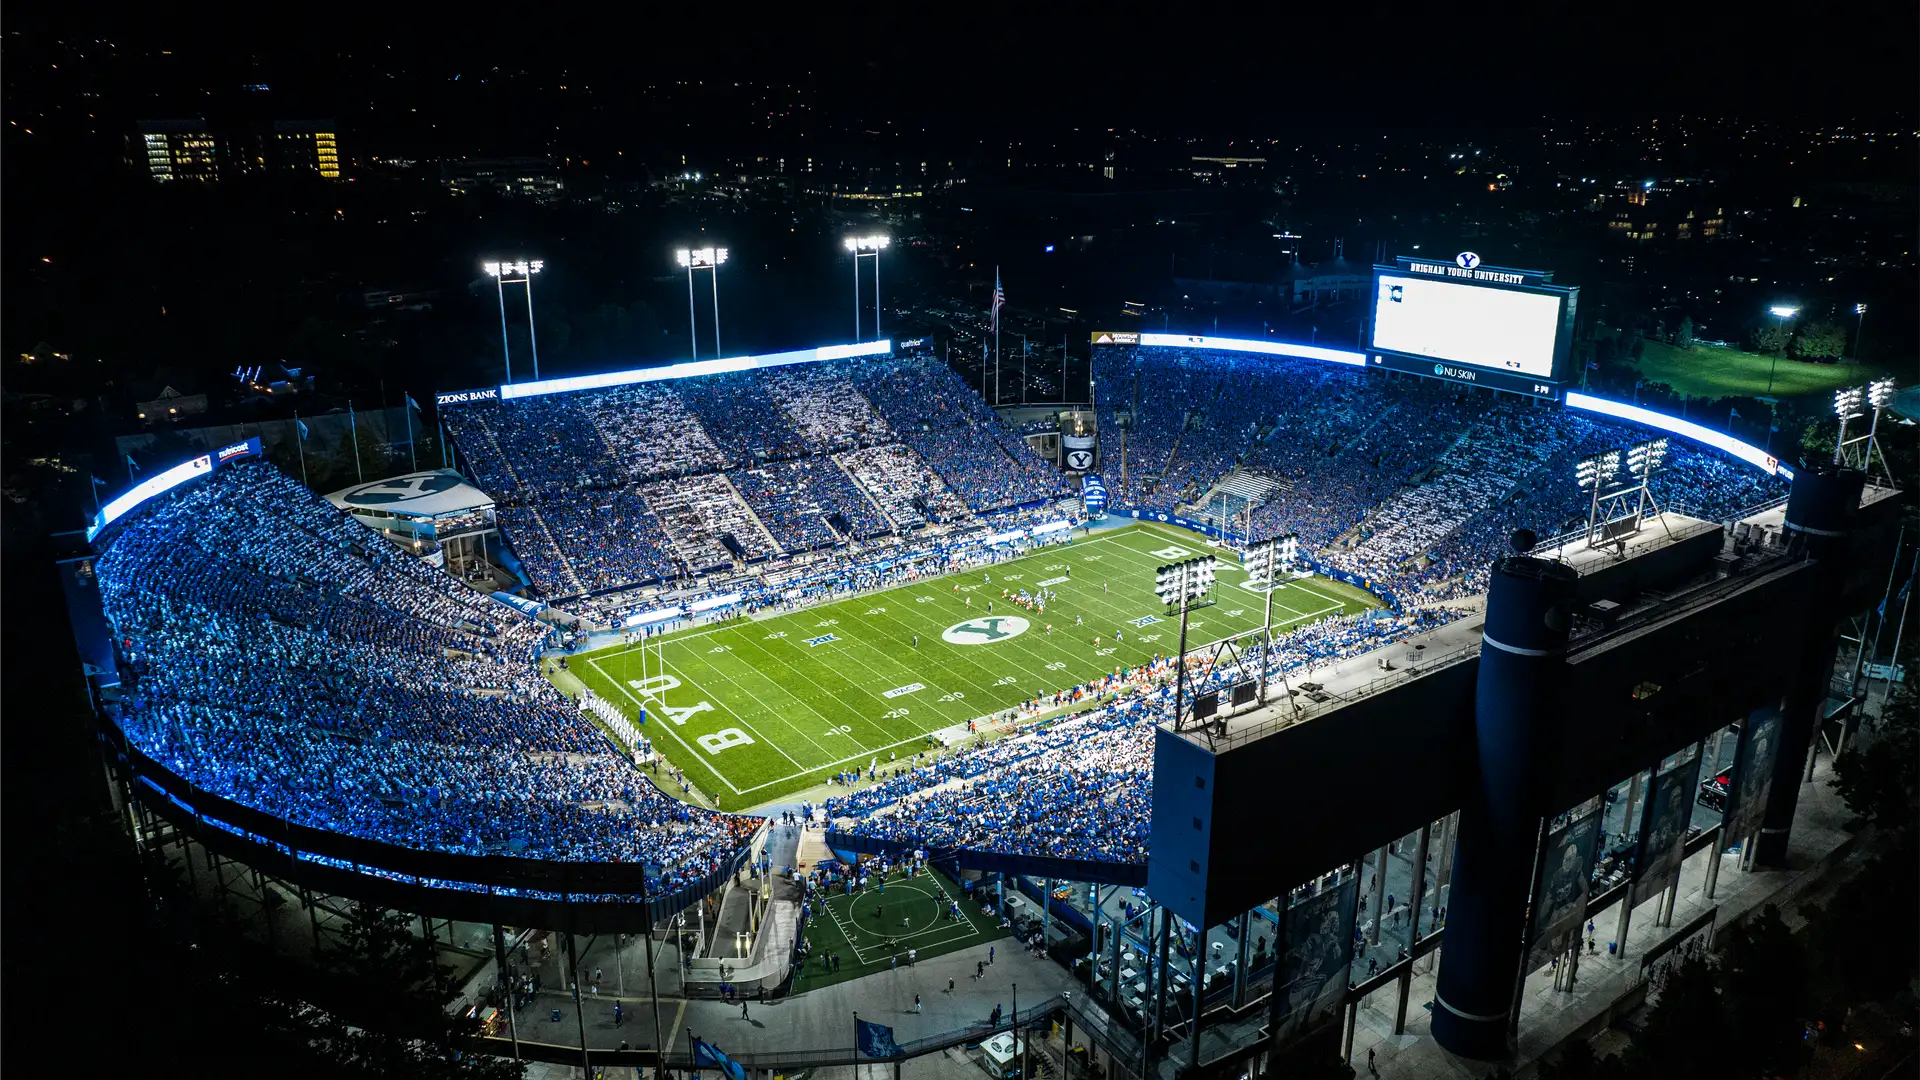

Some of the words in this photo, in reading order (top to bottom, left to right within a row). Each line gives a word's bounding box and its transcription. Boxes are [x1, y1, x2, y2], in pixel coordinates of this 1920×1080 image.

[1460, 254, 1476, 267] Y
[1410, 263, 1445, 275] BRIGHAM
[1447, 266, 1472, 278] YOUNG
[1474, 270, 1524, 284] UNIVERSITY
[1444, 367, 1457, 377] NU
[1458, 369, 1476, 381] SKIN
[437, 393, 468, 404] ZIONS
[469, 389, 497, 401] BANK
[219, 442, 249, 458] nutricost
[1071, 453, 1090, 467] Y
[820, 619, 839, 627] 30
[951, 618, 1010, 640] Y
[768, 631, 788, 639] 20
[715, 645, 733, 653] 10
[1045, 662, 1066, 671] 50
[998, 676, 1017, 686] 40
[943, 691, 965, 702] 30
[887, 708, 910, 719] 20
[830, 725, 852, 736] 10
